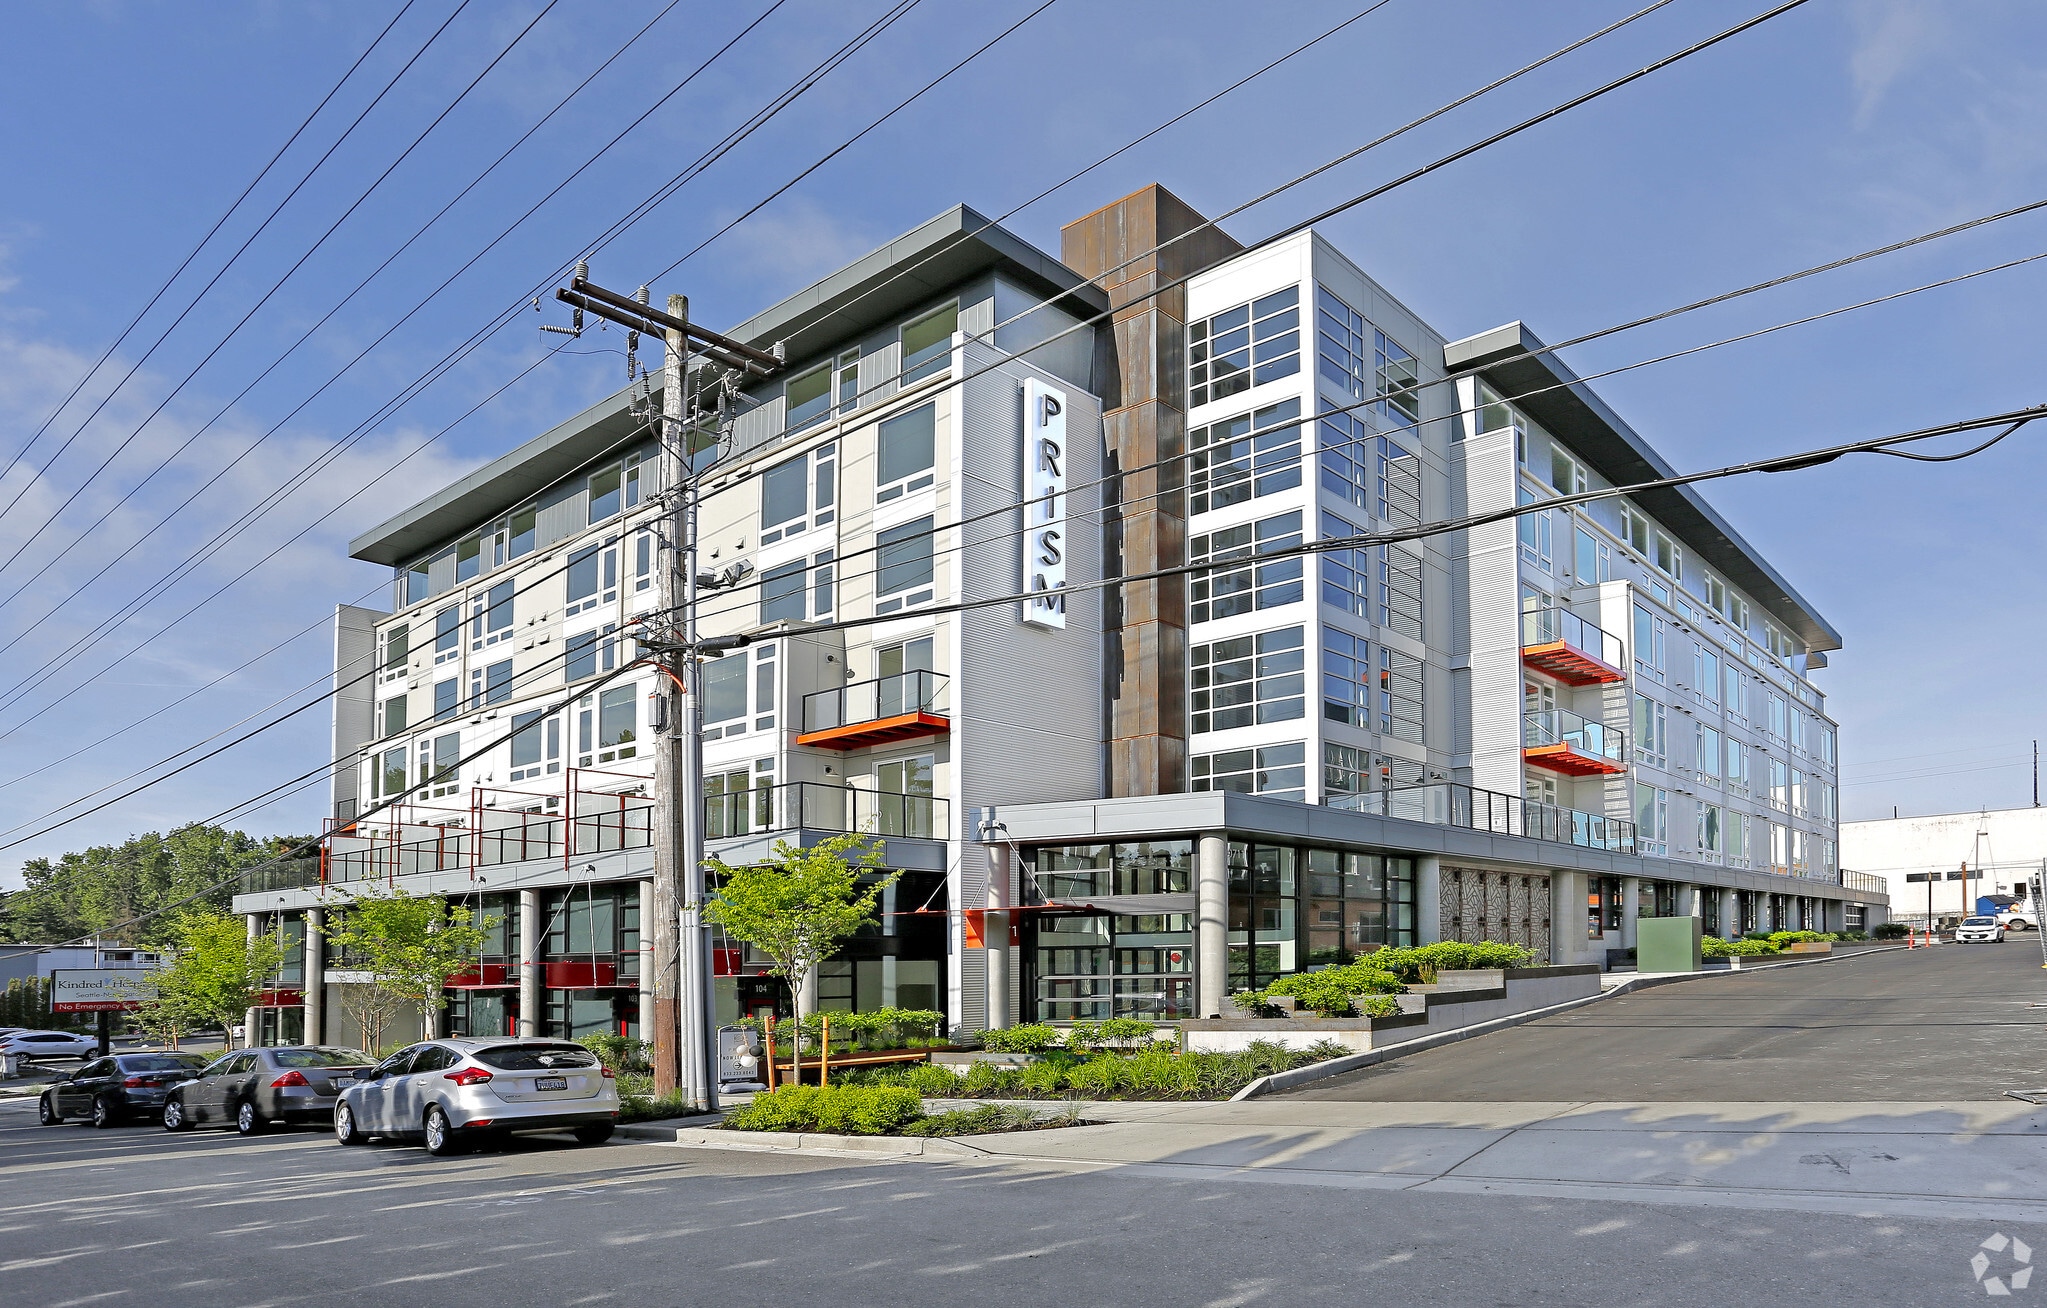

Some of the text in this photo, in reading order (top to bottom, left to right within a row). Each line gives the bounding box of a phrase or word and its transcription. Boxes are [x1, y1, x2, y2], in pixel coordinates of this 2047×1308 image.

[1036, 393, 1066, 614] PRISM
[58, 980, 102, 989] Kindred
[755, 984, 767, 993] 104
[75, 1002, 120, 1010] Emergency
